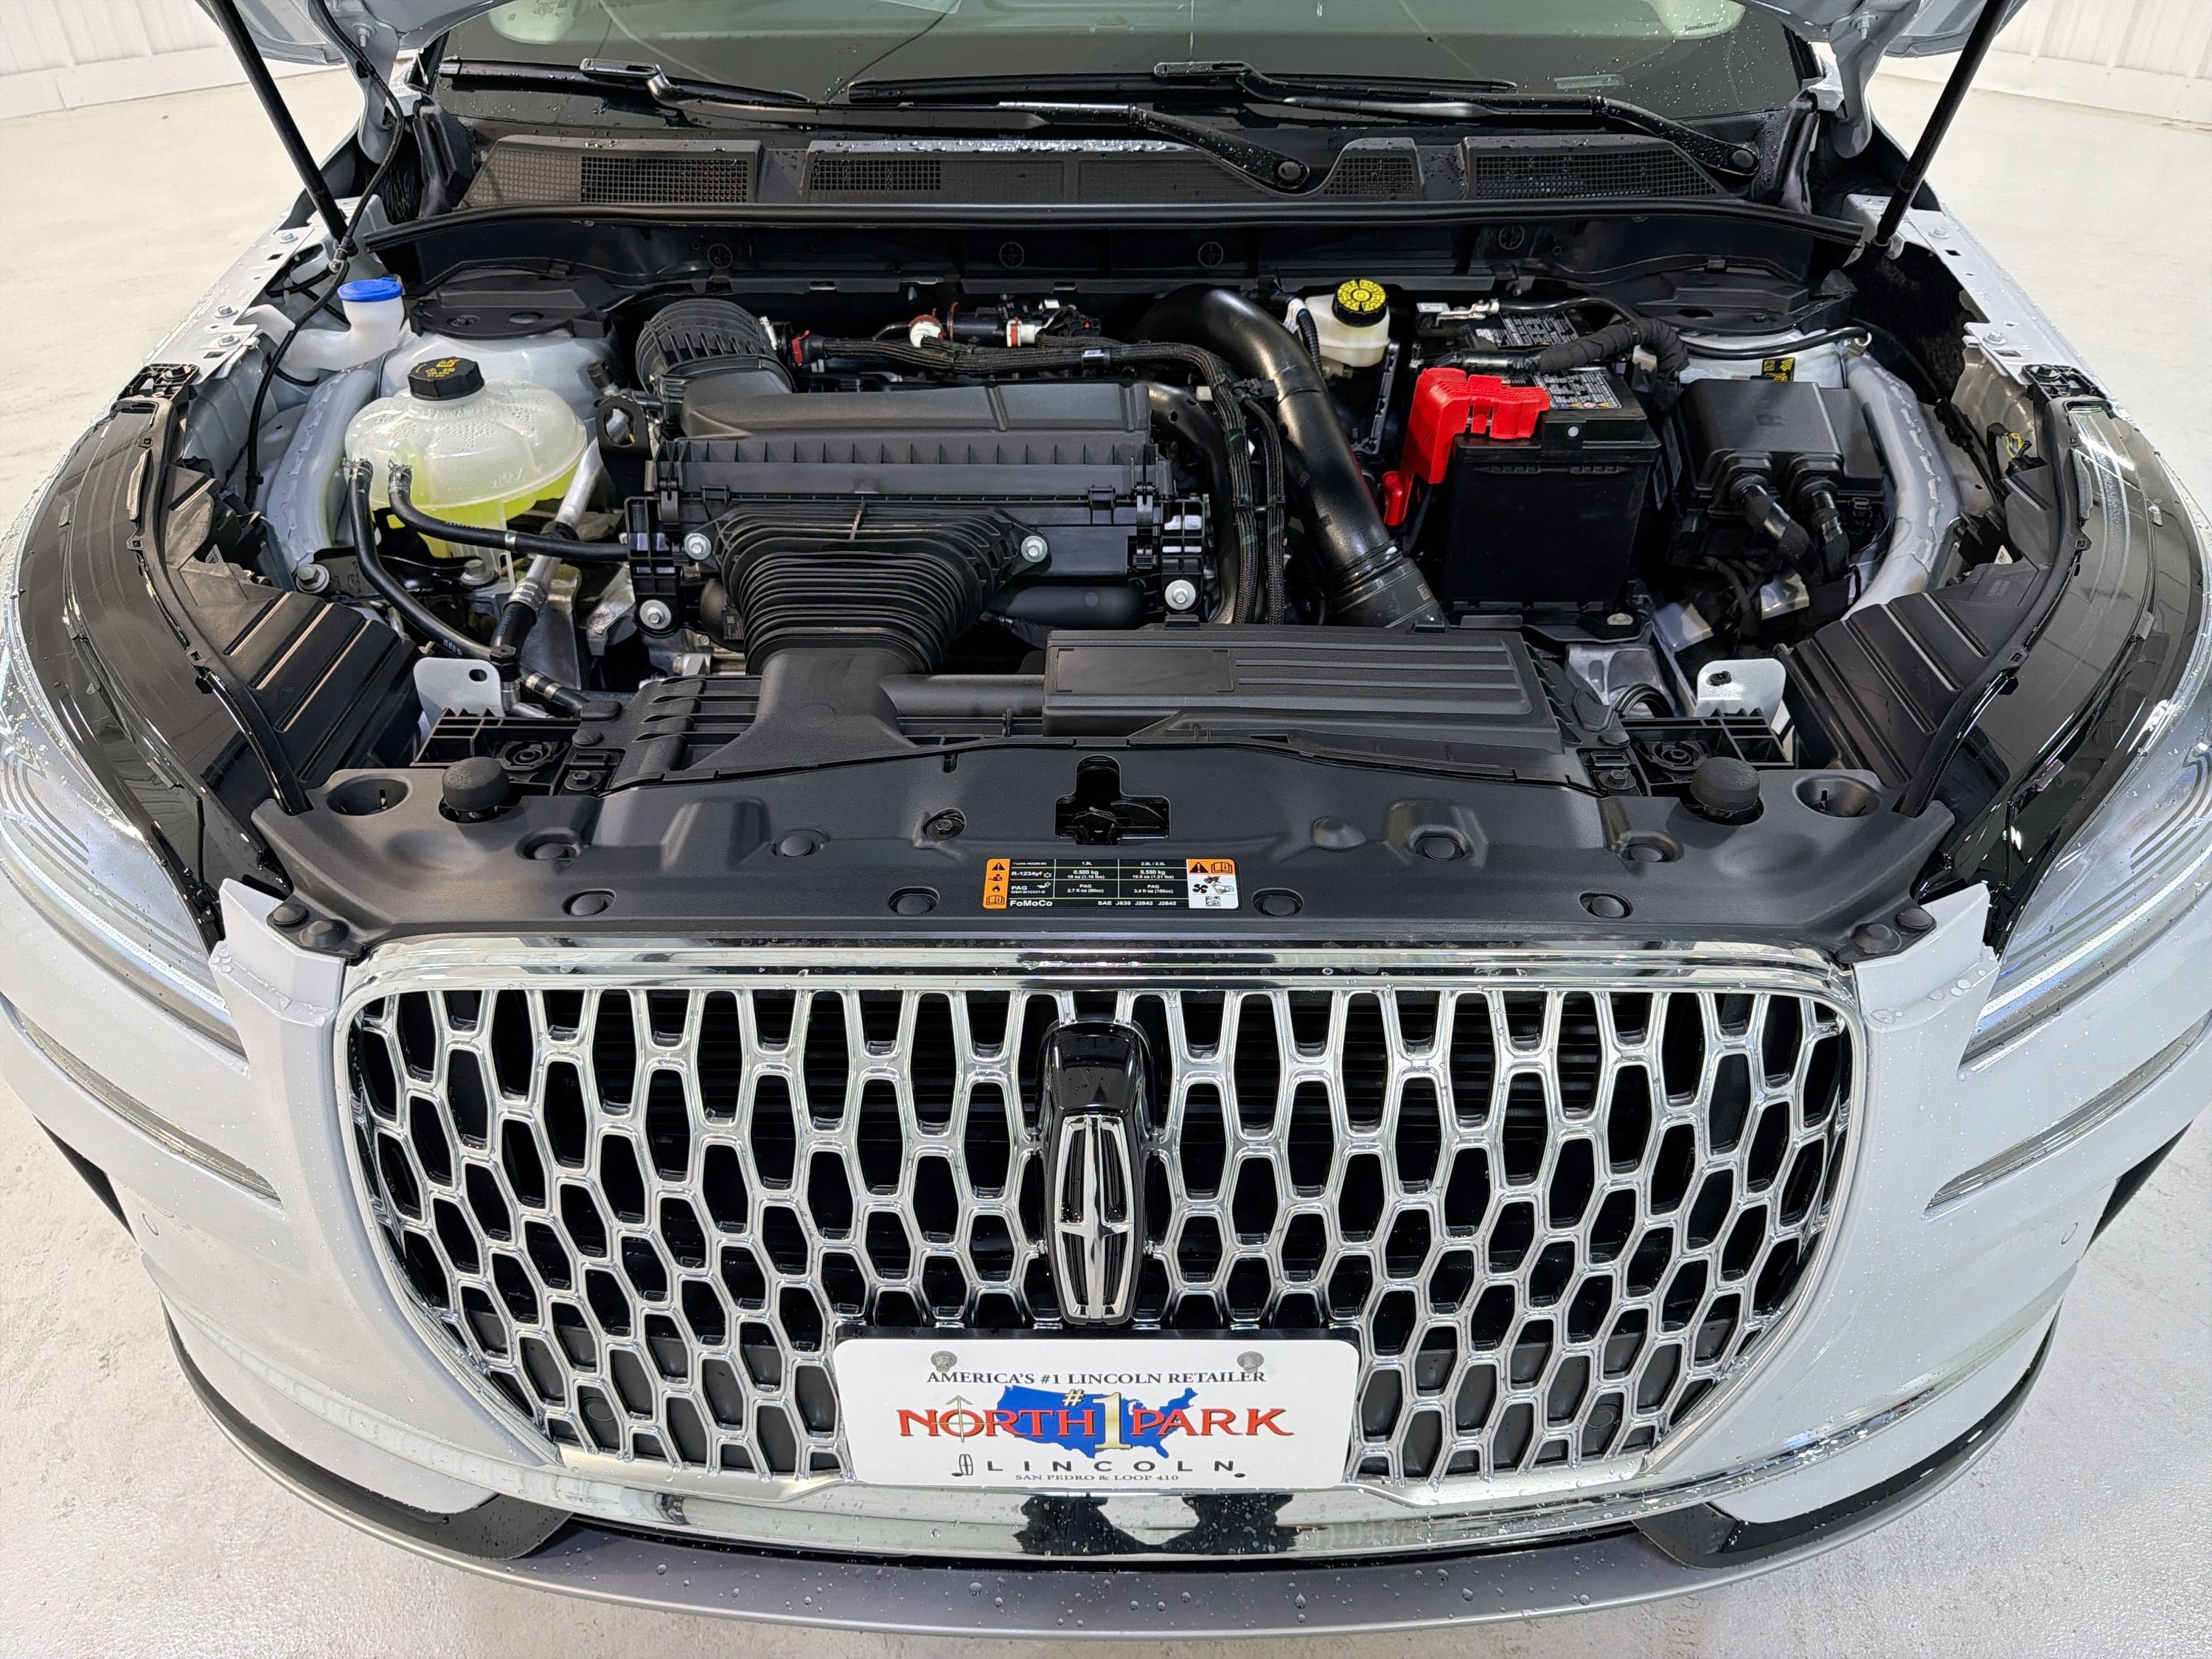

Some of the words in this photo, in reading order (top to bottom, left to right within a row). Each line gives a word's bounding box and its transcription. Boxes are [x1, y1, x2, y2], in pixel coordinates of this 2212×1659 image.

[926, 1371, 1035, 1385] AMERICA'S
[1040, 1374, 1061, 1385] #1
[1068, 1373, 1162, 1384] LINCOLN
[1167, 1371, 1267, 1383] RETAILER
[897, 1409, 1096, 1438] NORTH
[1130, 1408, 1295, 1436] PARK
[987, 1460, 1234, 1472] LINCOLN
